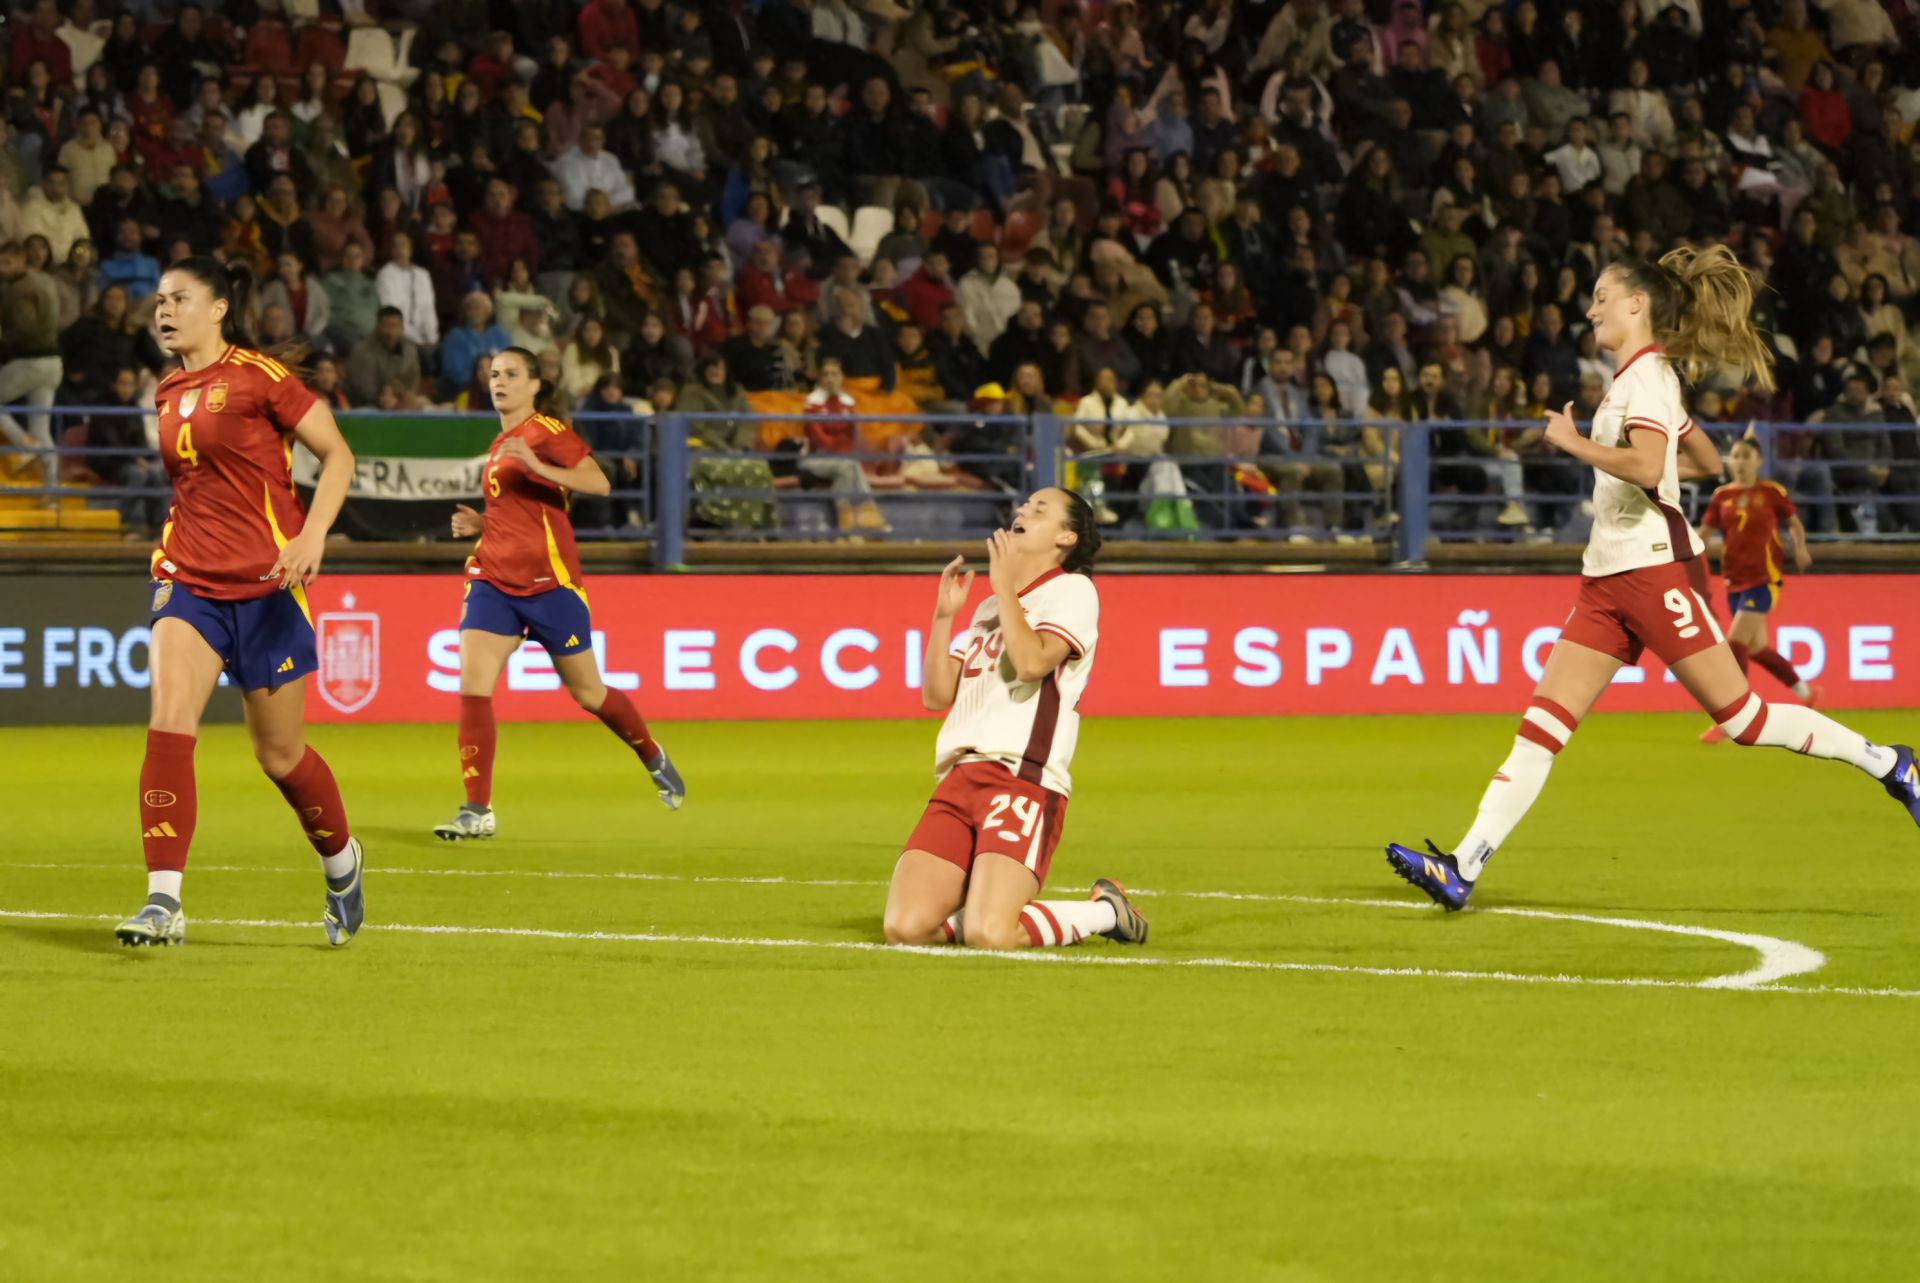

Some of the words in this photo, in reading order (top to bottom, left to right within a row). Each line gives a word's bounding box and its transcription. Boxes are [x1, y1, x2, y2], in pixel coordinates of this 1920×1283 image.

[176, 422, 198, 467] 4
[488, 465, 500, 498] 5
[1736, 509, 1748, 532] 7
[1663, 587, 1693, 628] 9
[1776, 625, 1895, 681] DE
[982, 794, 1041, 838] 24
